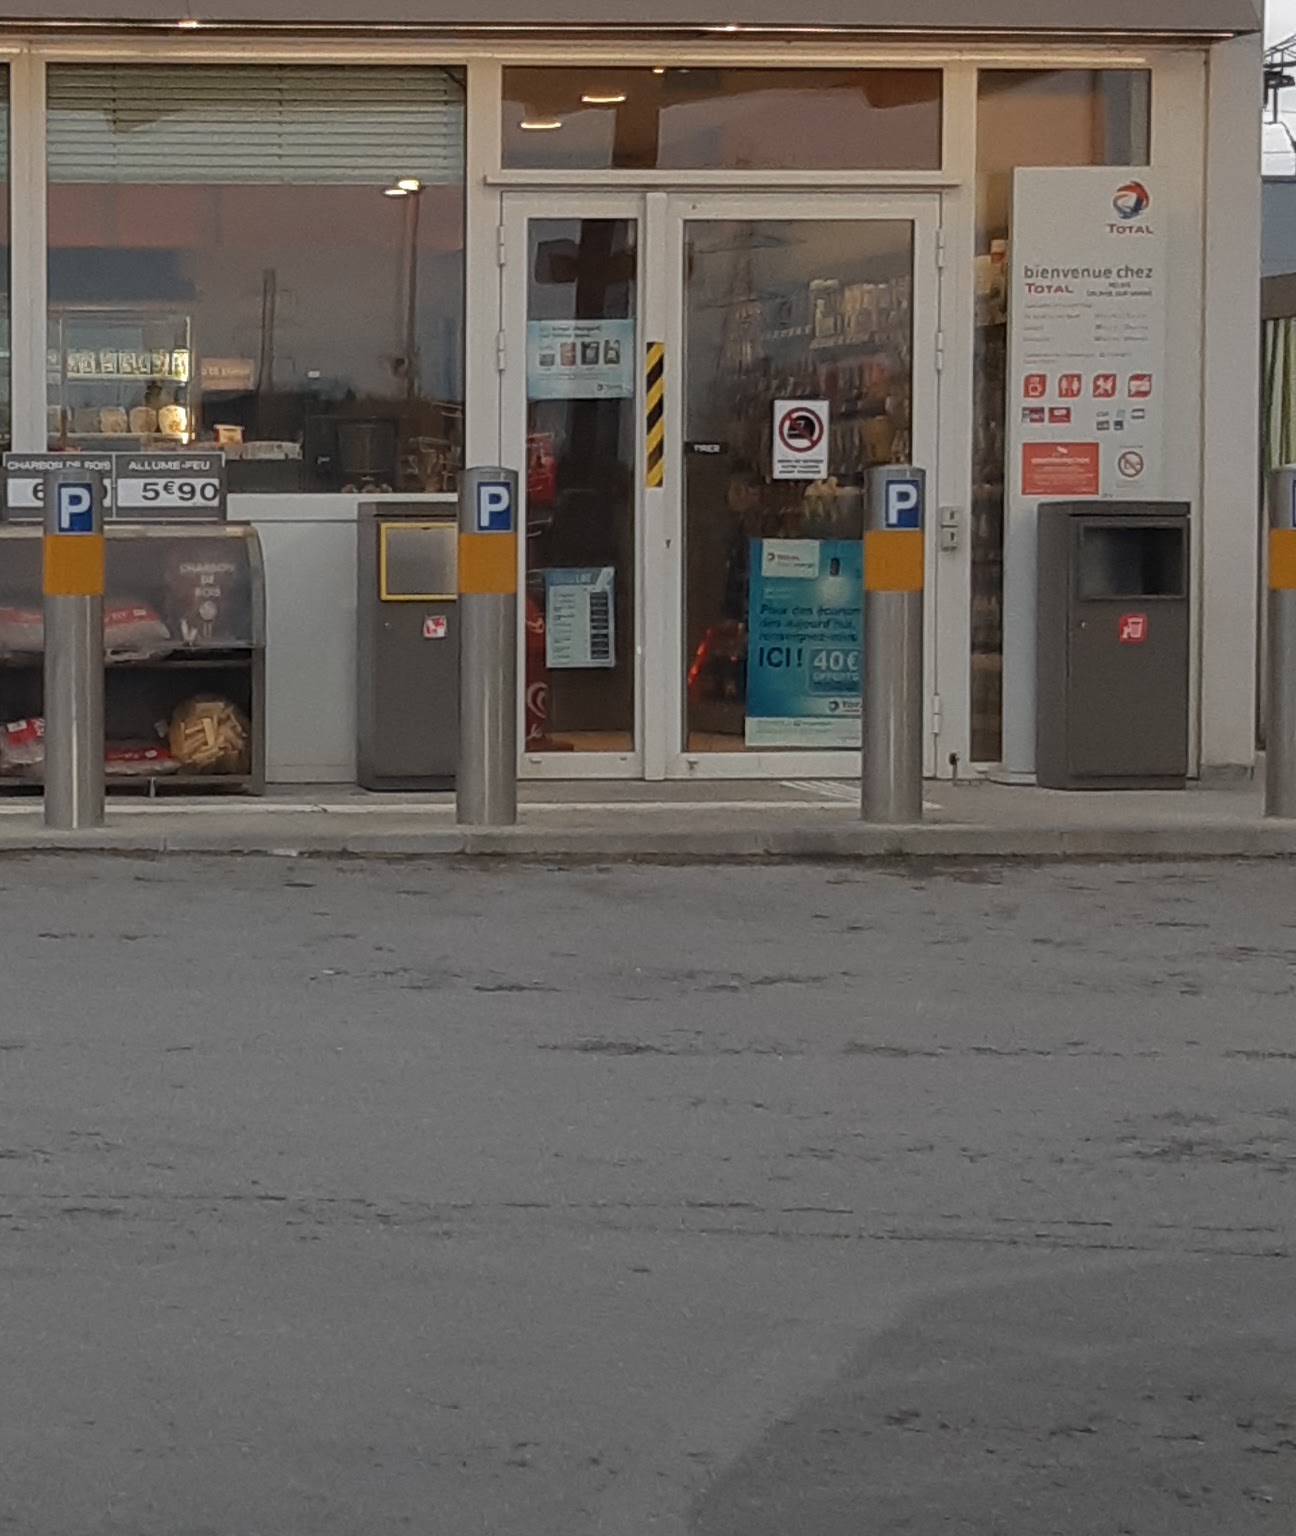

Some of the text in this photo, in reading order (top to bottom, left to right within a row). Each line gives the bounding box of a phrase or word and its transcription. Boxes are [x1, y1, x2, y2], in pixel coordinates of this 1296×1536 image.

[1108, 223, 1154, 235] TOTAL
[1023, 264, 1153, 280] bienvenue chez
[1025, 282, 1074, 295] TOTAL
[141, 480, 220, 502] 5€90
[60, 487, 91, 529] P
[480, 486, 510, 527] P
[888, 484, 918, 524] P
[759, 646, 791, 668] ICI
